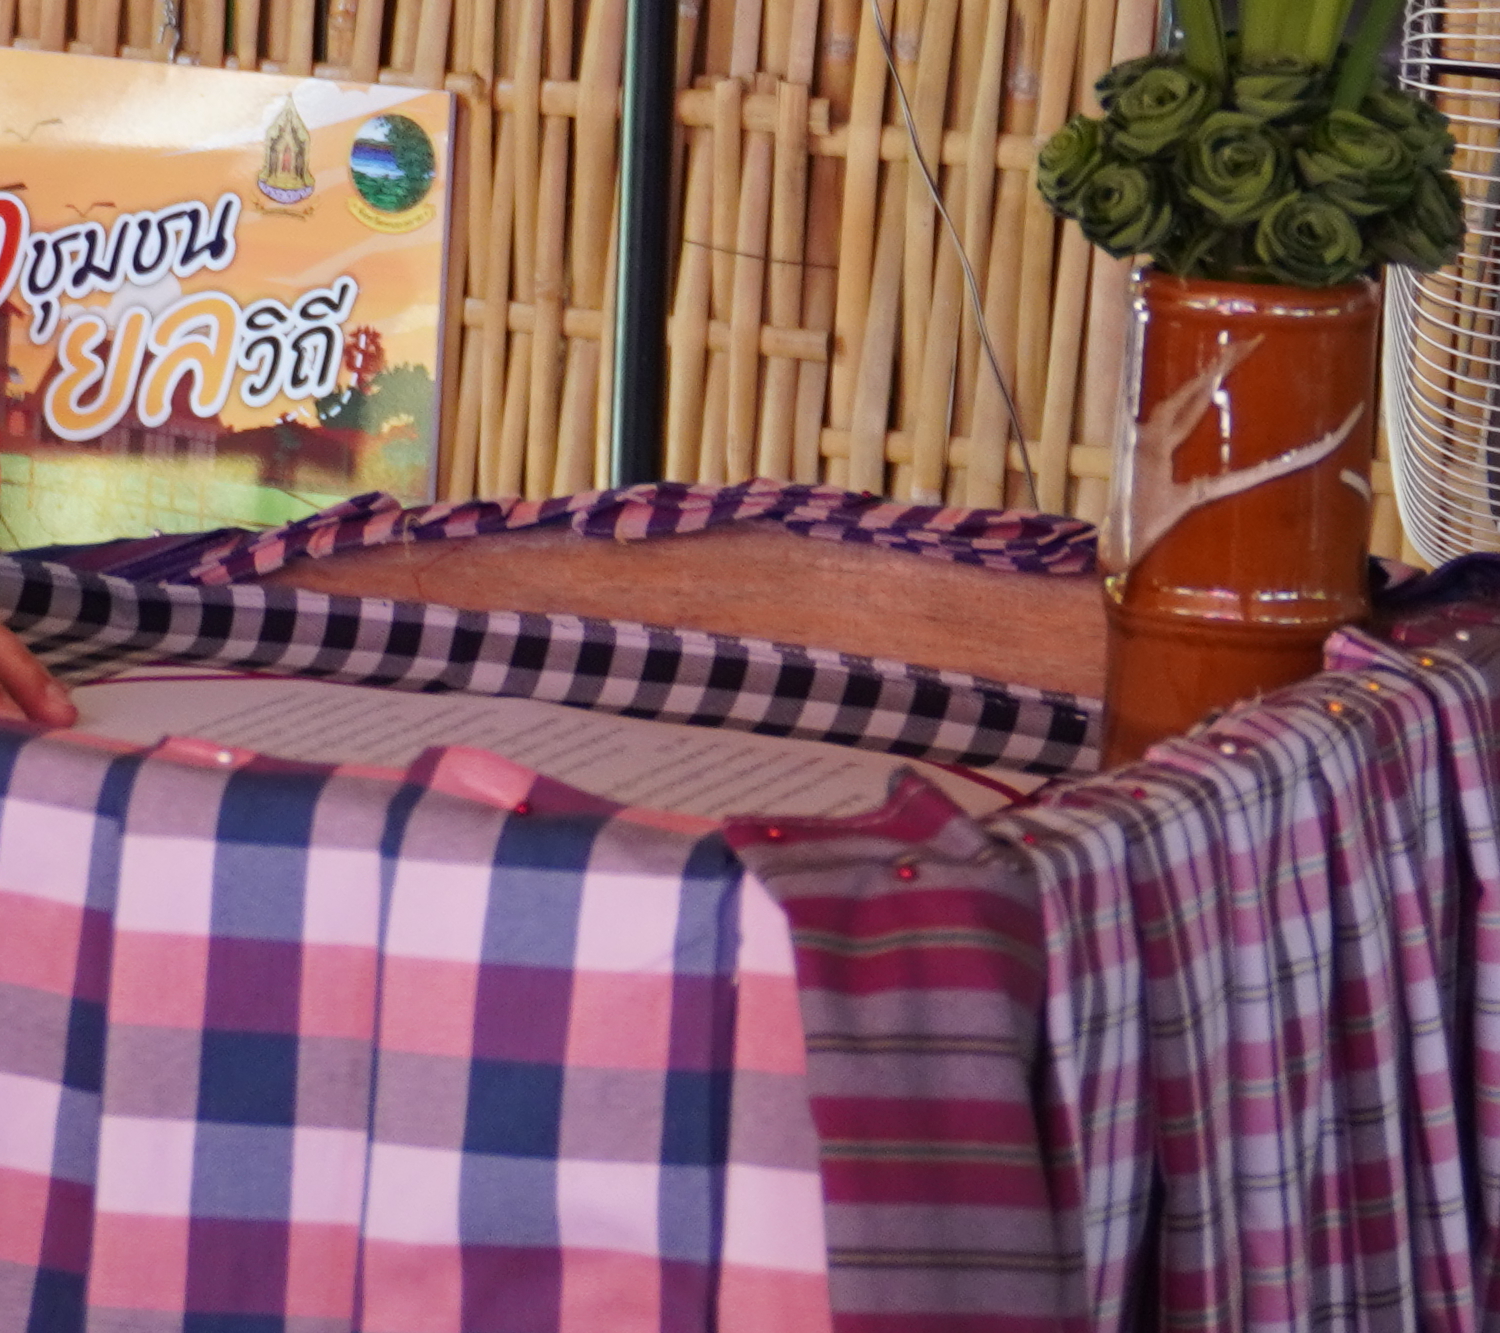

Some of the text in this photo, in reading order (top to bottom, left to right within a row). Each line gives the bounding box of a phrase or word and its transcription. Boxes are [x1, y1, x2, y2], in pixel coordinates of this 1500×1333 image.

[27, 196, 236, 337] ชุมชน
[49, 280, 352, 433] ยล วิถี
